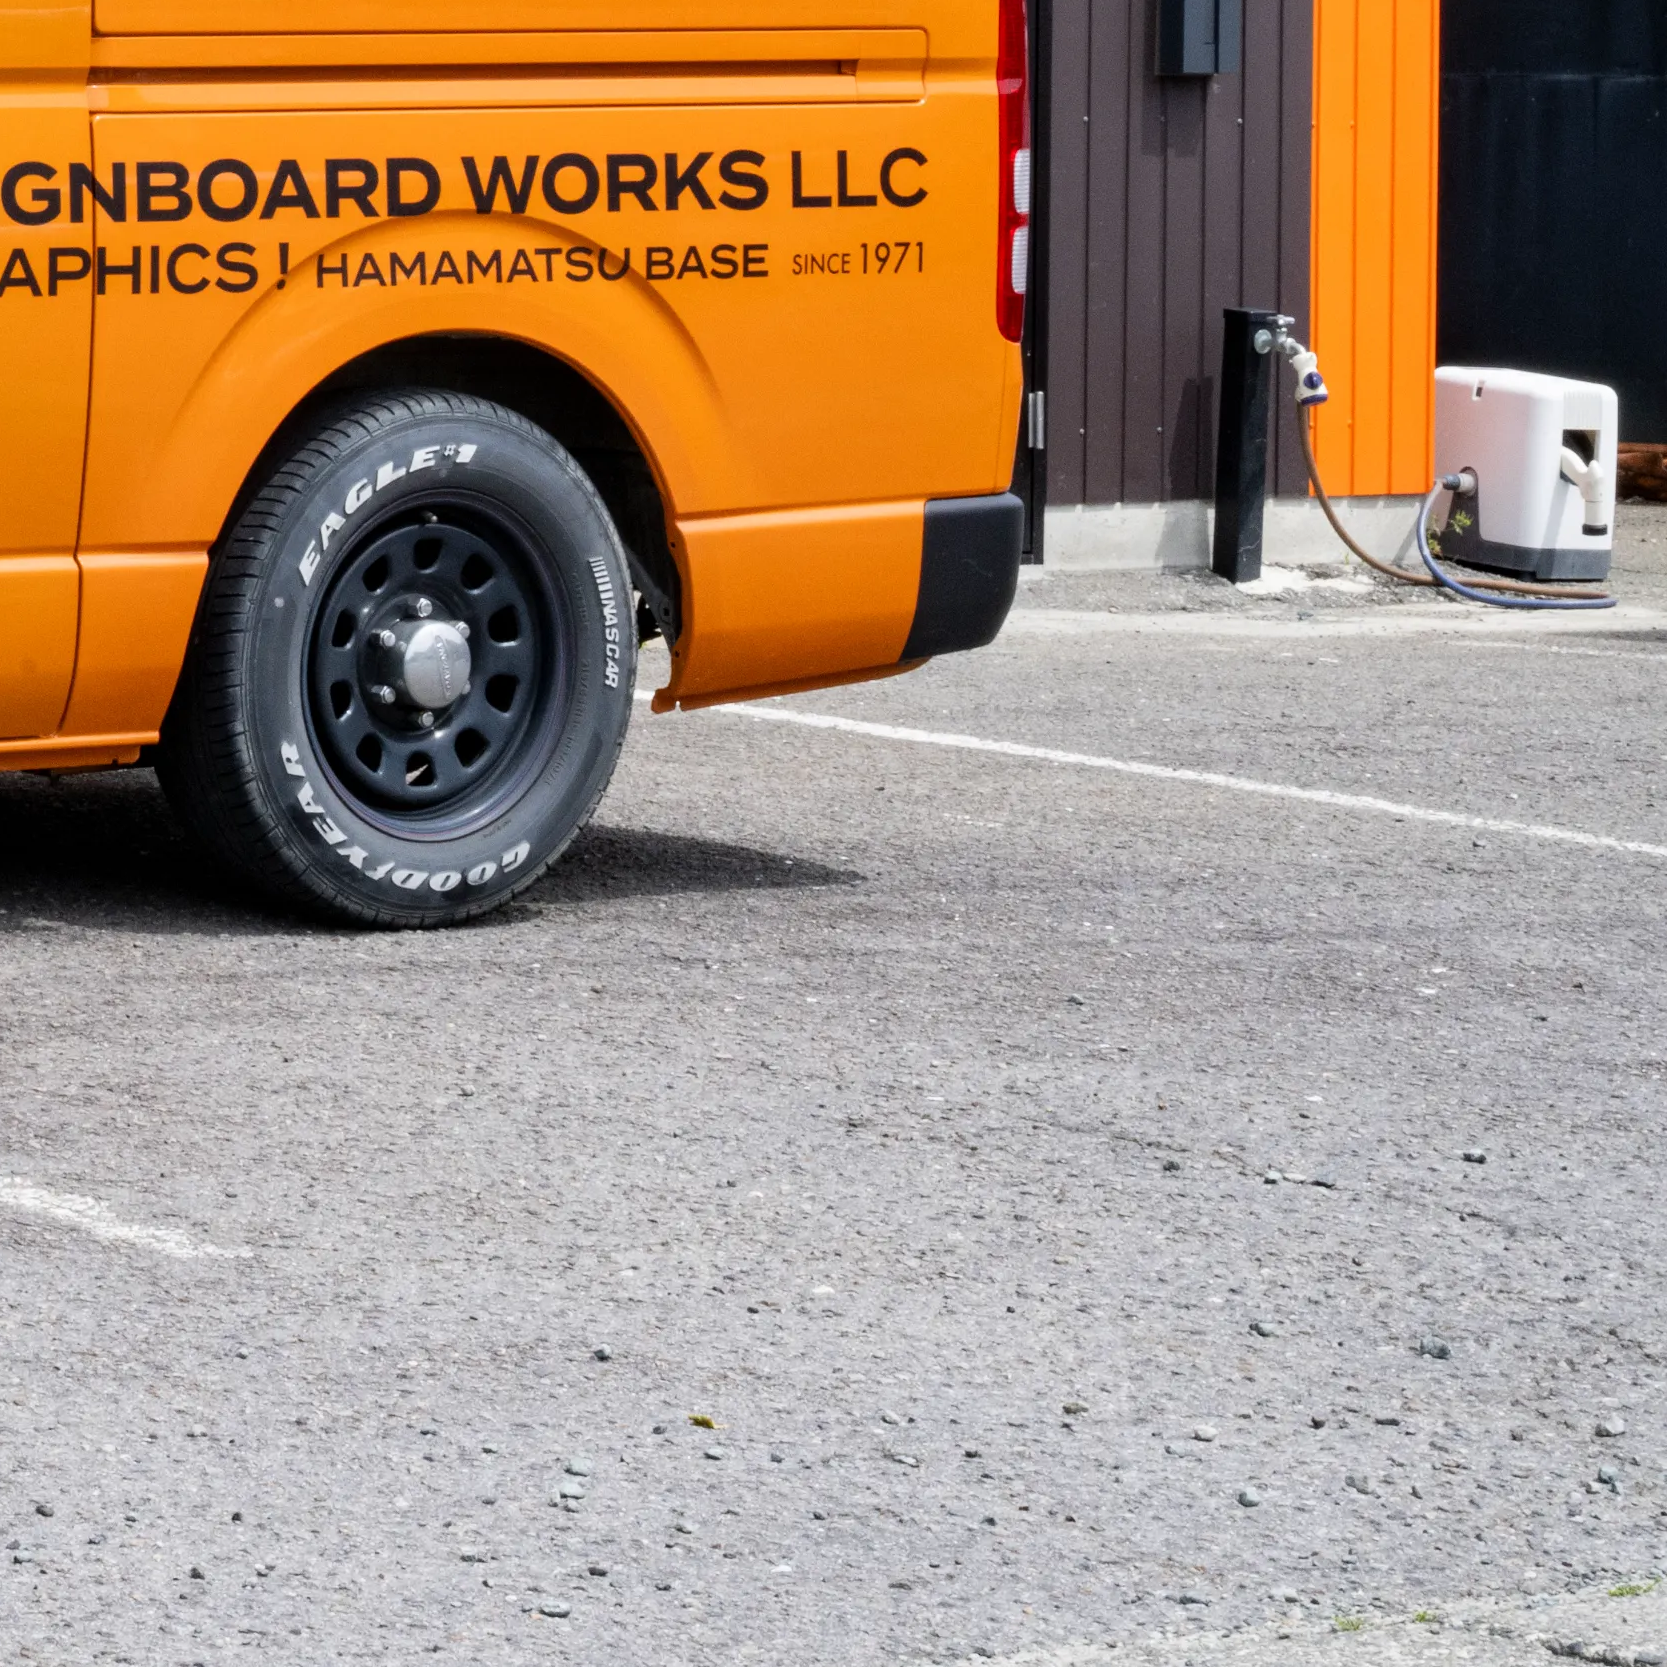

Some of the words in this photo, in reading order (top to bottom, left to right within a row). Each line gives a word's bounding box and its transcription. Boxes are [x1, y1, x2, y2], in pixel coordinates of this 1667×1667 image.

[461, 149, 769, 216] WORKS
[791, 147, 928, 208] LLC
[317, 245, 631, 289] HAMAMATSU
[646, 243, 769, 281] BASE
[792, 252, 851, 275] SINCE
[860, 241, 924, 274] 1971
[281, 740, 531, 892] GOODYEAR
